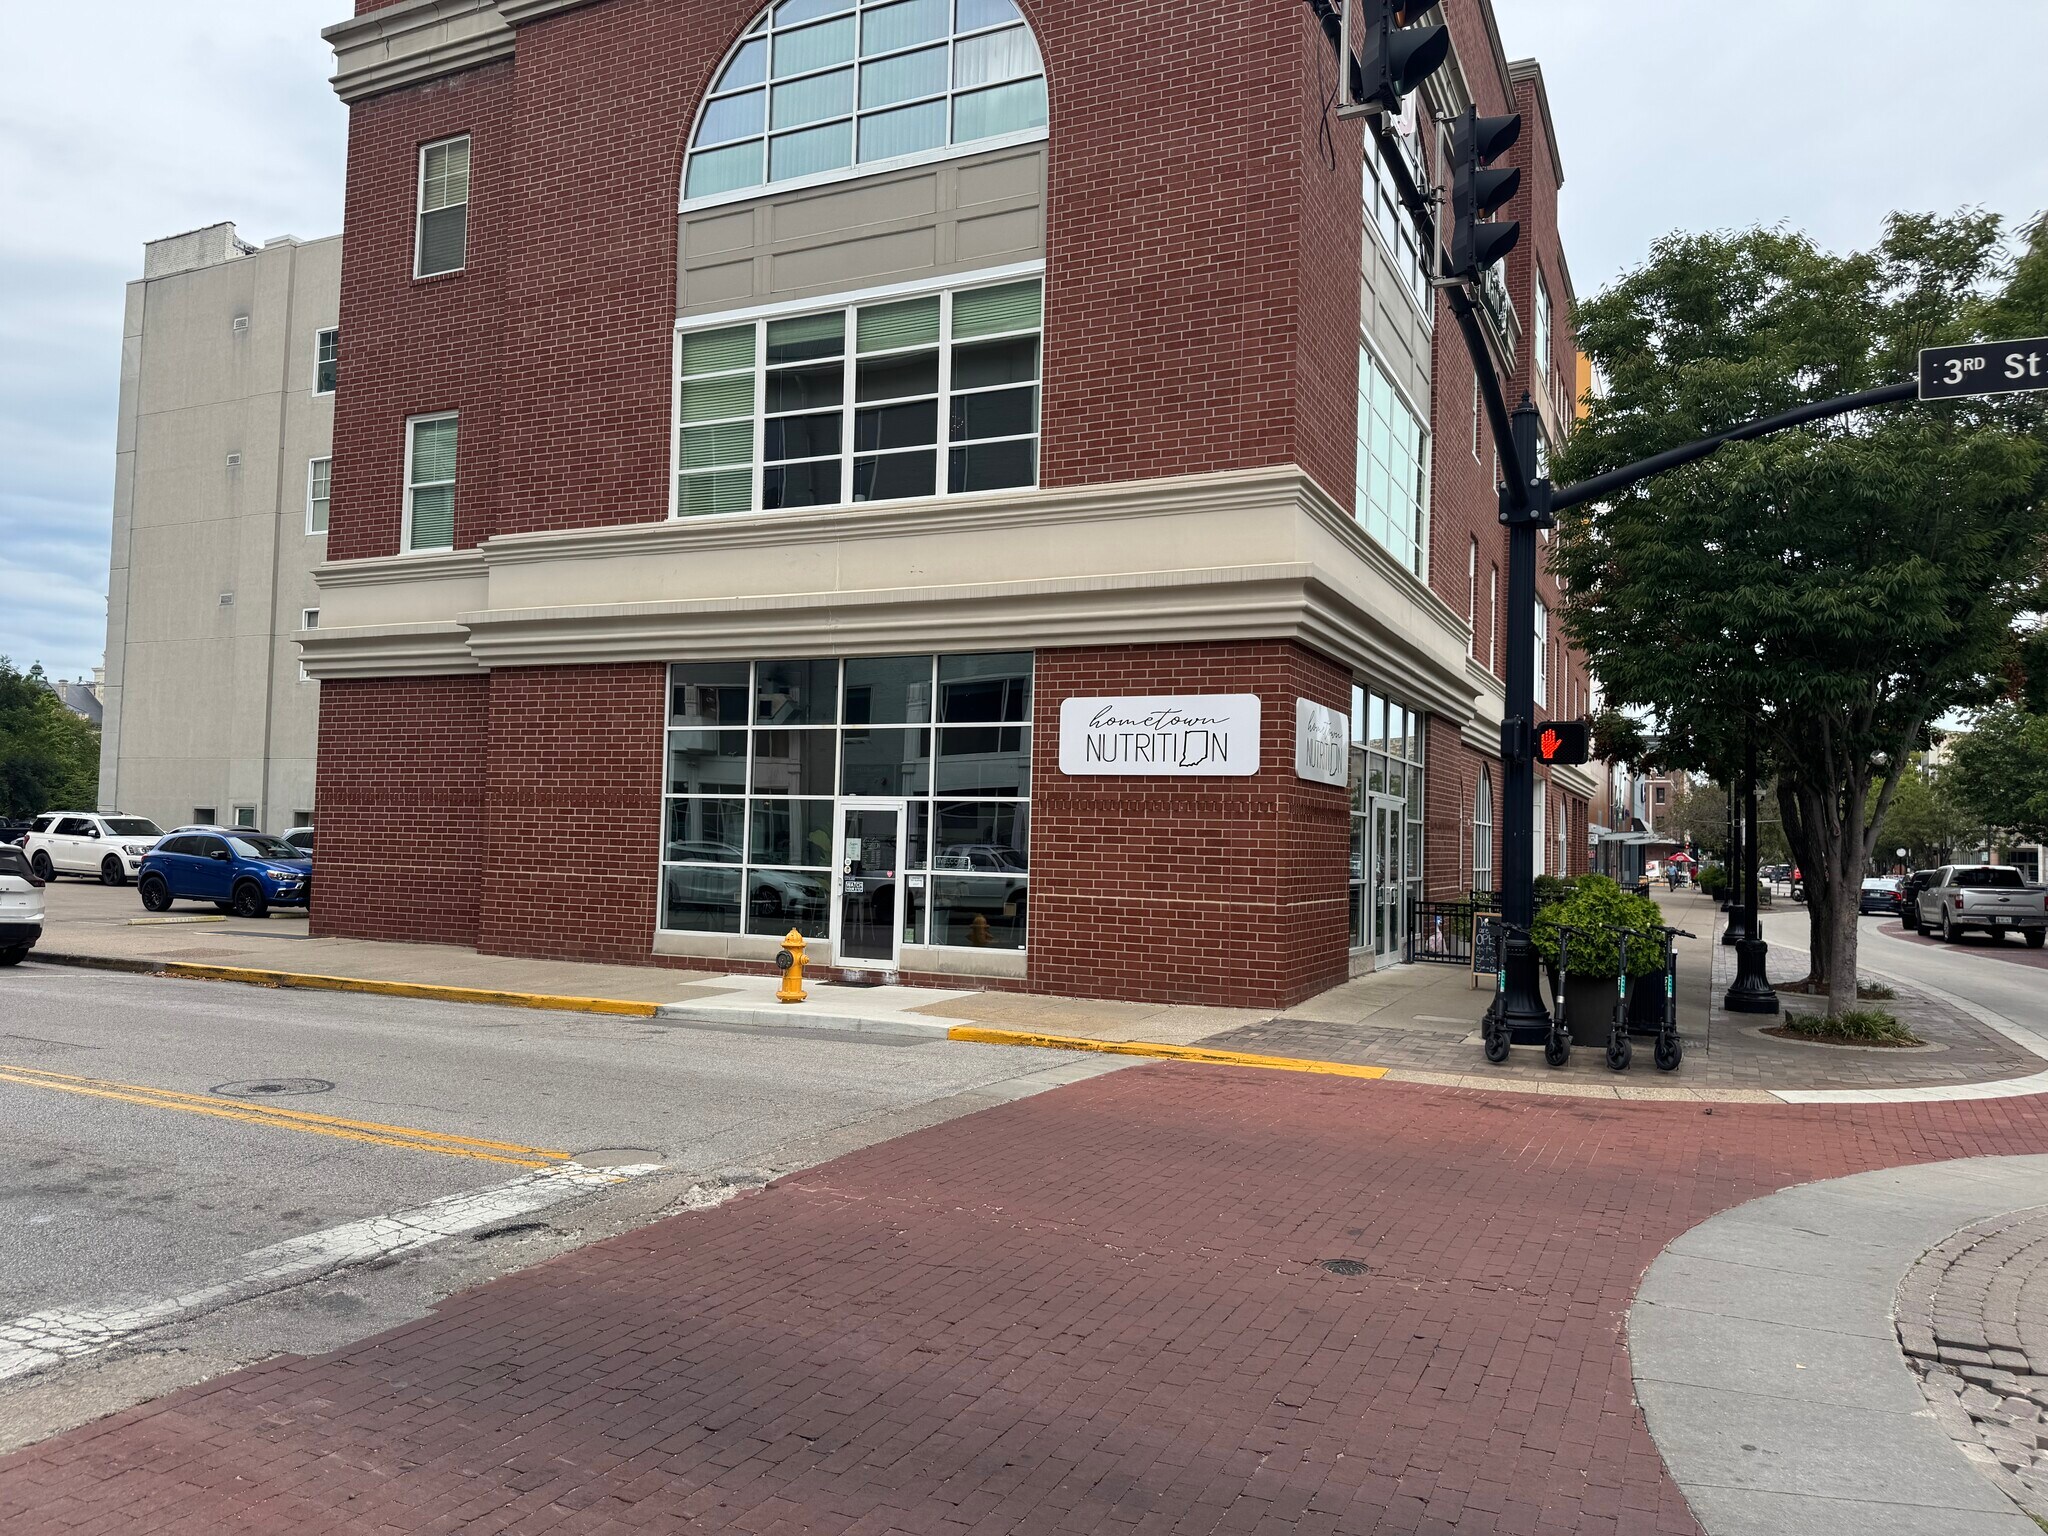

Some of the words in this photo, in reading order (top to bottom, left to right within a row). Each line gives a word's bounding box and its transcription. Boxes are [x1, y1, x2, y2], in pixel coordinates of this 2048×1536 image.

[1943, 357, 1986, 385] 3RD
[2004, 352, 2041, 379] St
[1089, 705, 1230, 731] hometown
